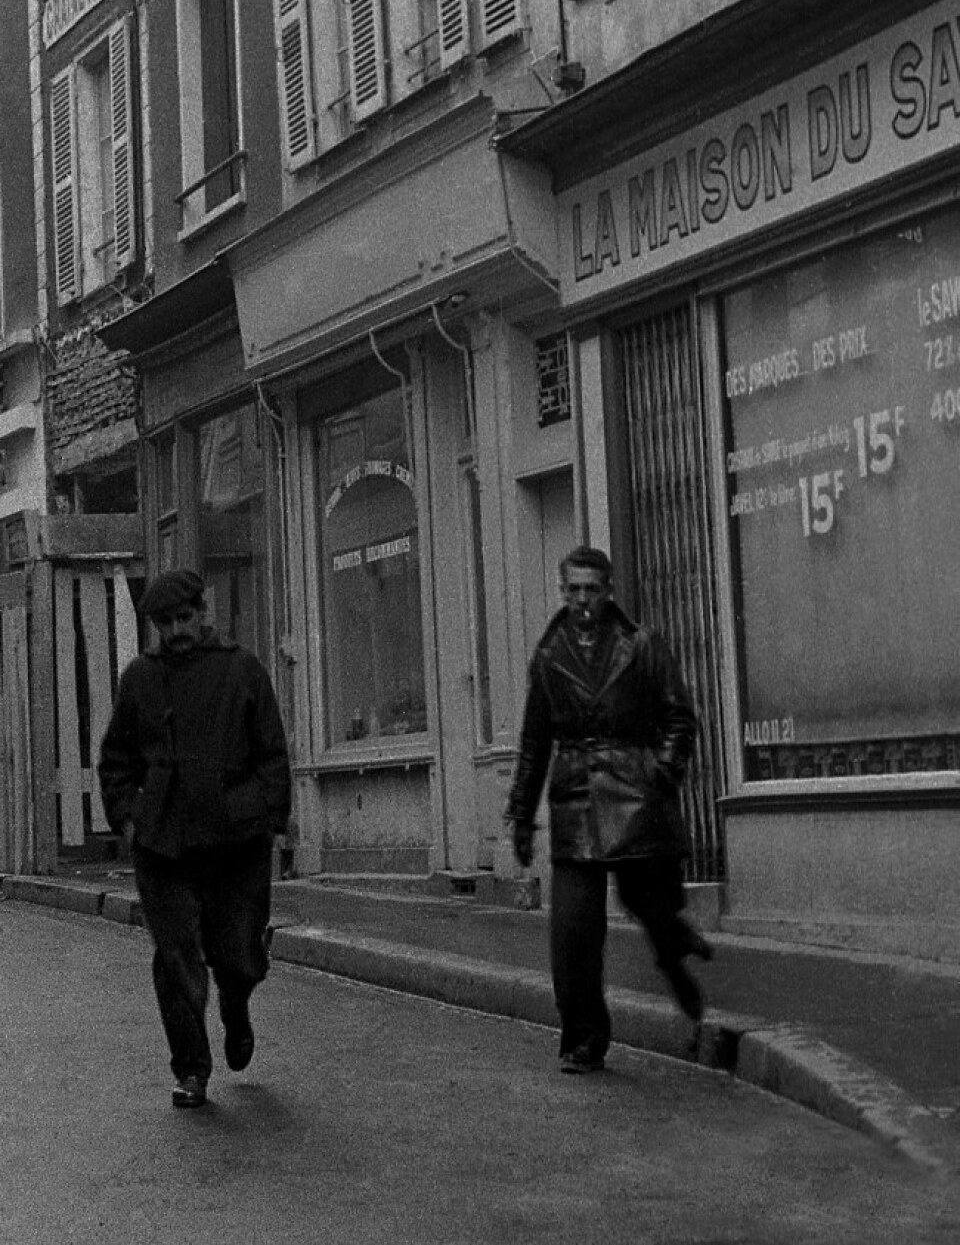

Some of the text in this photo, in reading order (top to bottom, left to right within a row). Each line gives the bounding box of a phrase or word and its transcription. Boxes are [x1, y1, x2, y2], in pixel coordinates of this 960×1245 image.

[572, 16, 960, 282] LA MAISON DU SA
[726, 365, 747, 398] DES
[813, 336, 836, 371] DES
[840, 325, 869, 363] PRIX
[930, 388, 960, 423] 40
